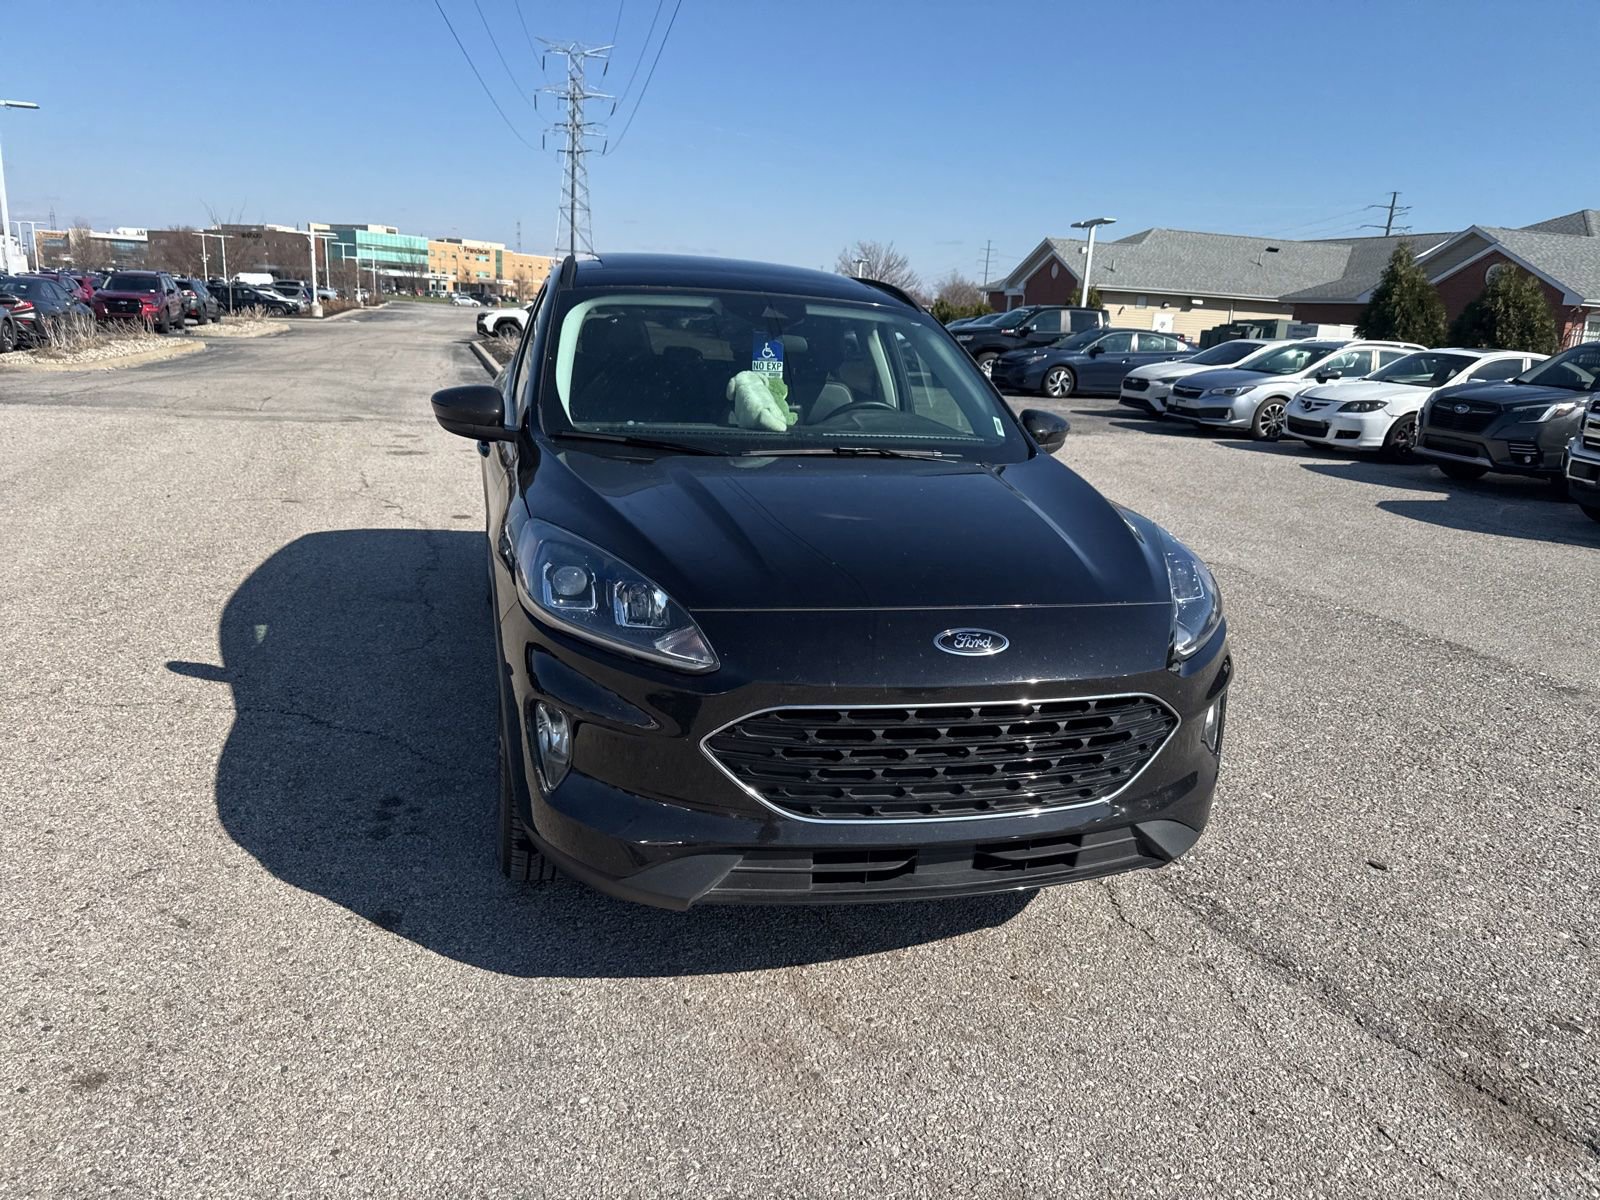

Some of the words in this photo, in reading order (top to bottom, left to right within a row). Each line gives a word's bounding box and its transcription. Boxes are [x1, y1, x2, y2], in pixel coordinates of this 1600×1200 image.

[753, 361, 764, 370] NO
[766, 361, 782, 371] EXP
[953, 632, 993, 649] Ford
